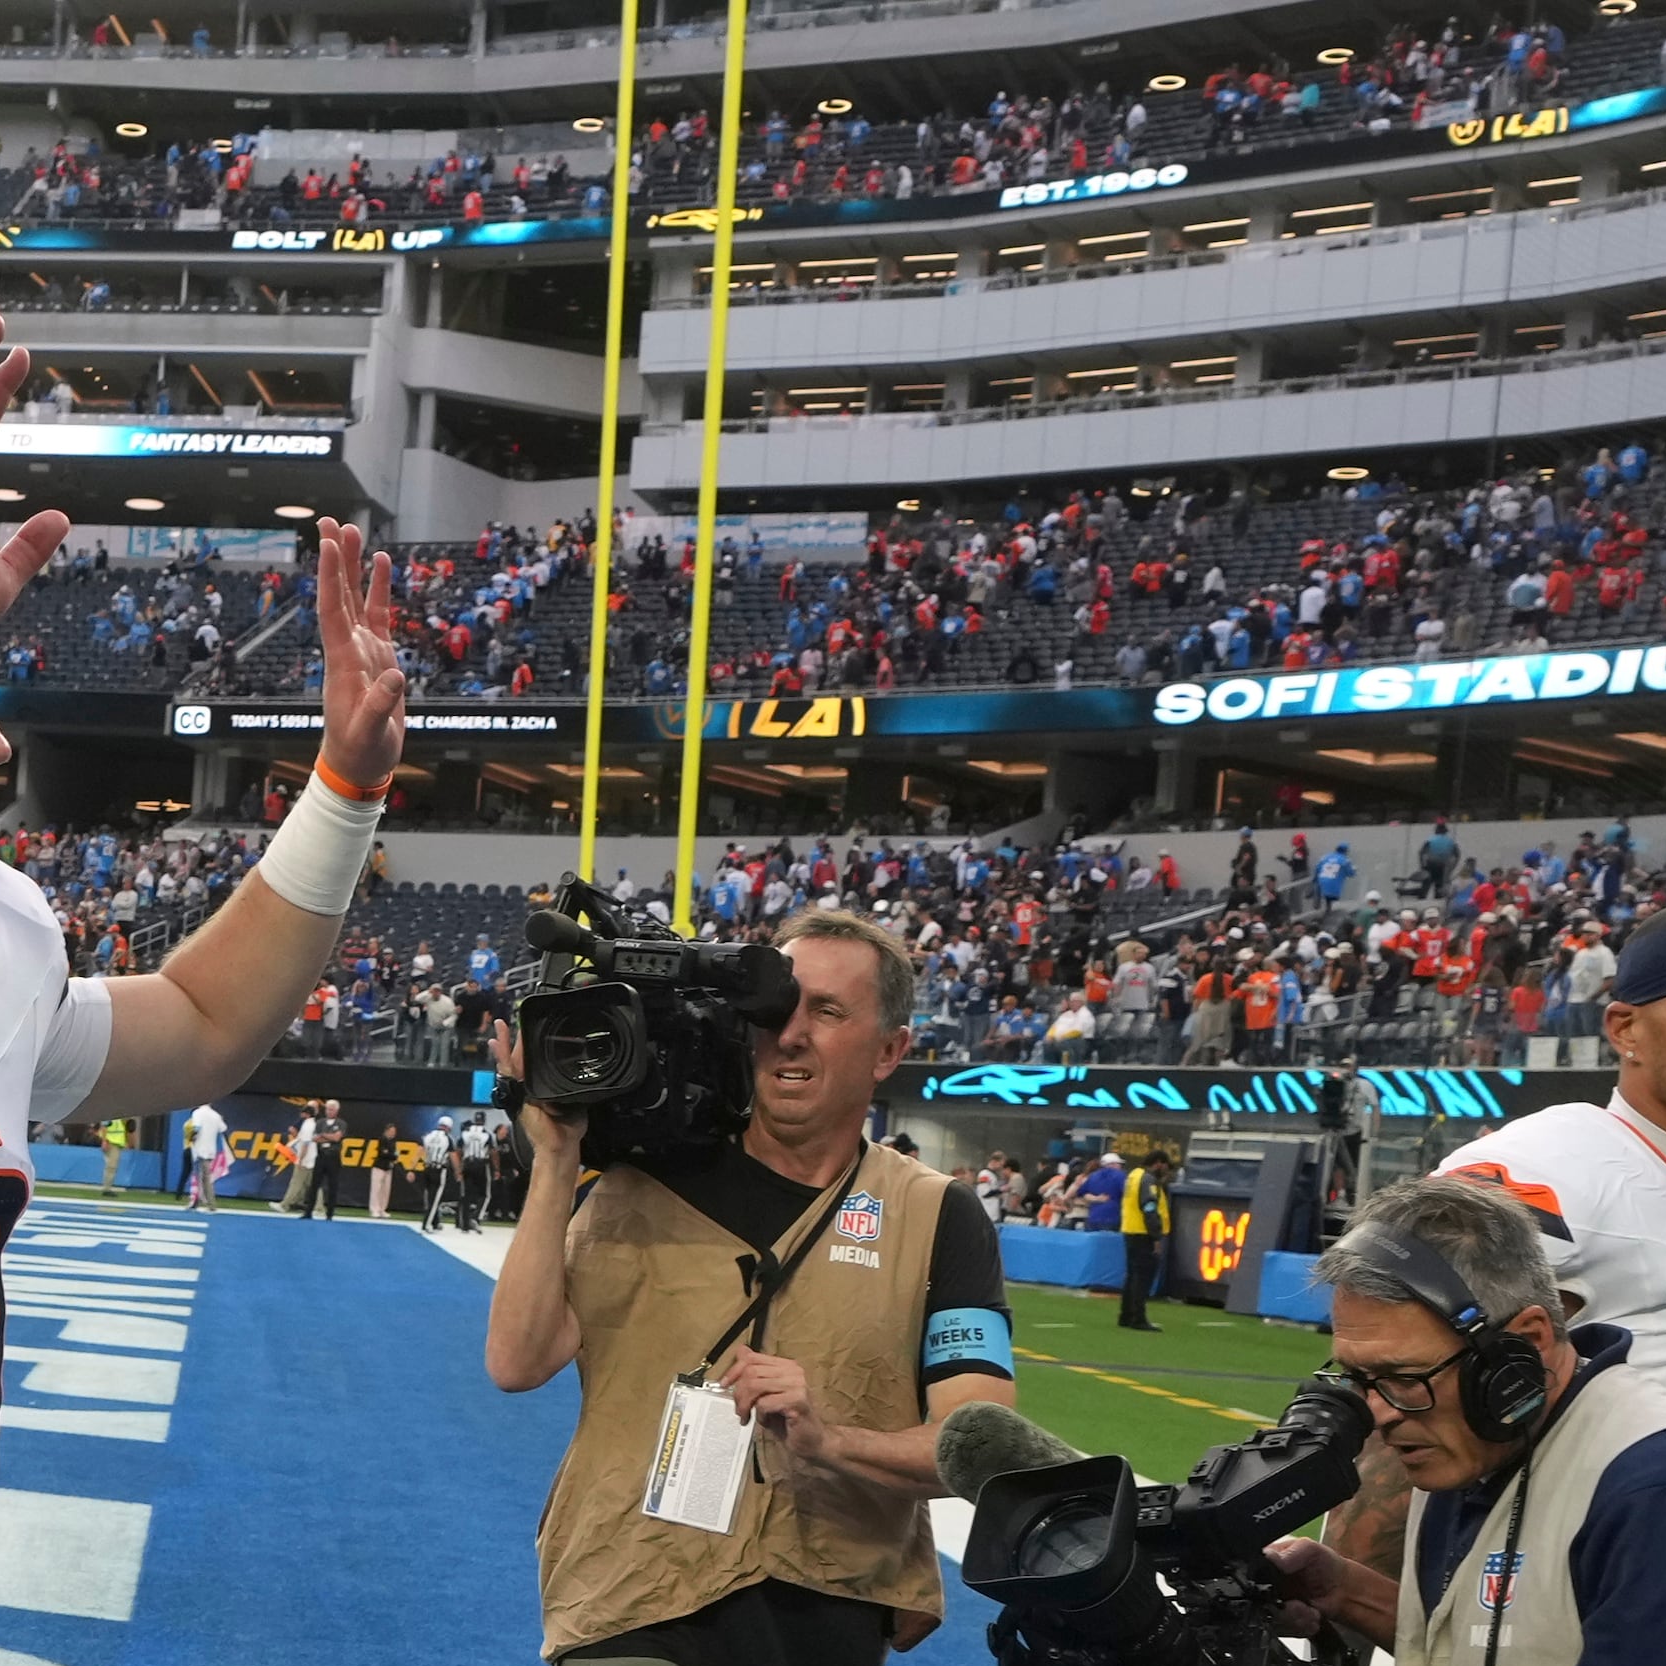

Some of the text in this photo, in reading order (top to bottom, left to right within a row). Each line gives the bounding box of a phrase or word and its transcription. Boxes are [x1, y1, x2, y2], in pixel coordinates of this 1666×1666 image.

[1000, 164, 1189, 208] EST. 1960
[232, 230, 326, 249] BOLT
[391, 230, 443, 250] UP
[129, 432, 332, 455] FANTASY LEADERS
[1154, 671, 1339, 725] SOFI
[425, 715, 492, 730] CHARGERS
[511, 716, 546, 730] ZACH
[841, 1212, 875, 1235] NFL
[829, 1244, 880, 1269] MEDIA
[943, 1317, 961, 1327] LAC
[929, 1327, 984, 1348] WEEK 5
[658, 1411, 681, 1474] THUNDER
[1253, 1488, 1306, 1523] XDCAM
[1485, 1575, 1515, 1602] NL
